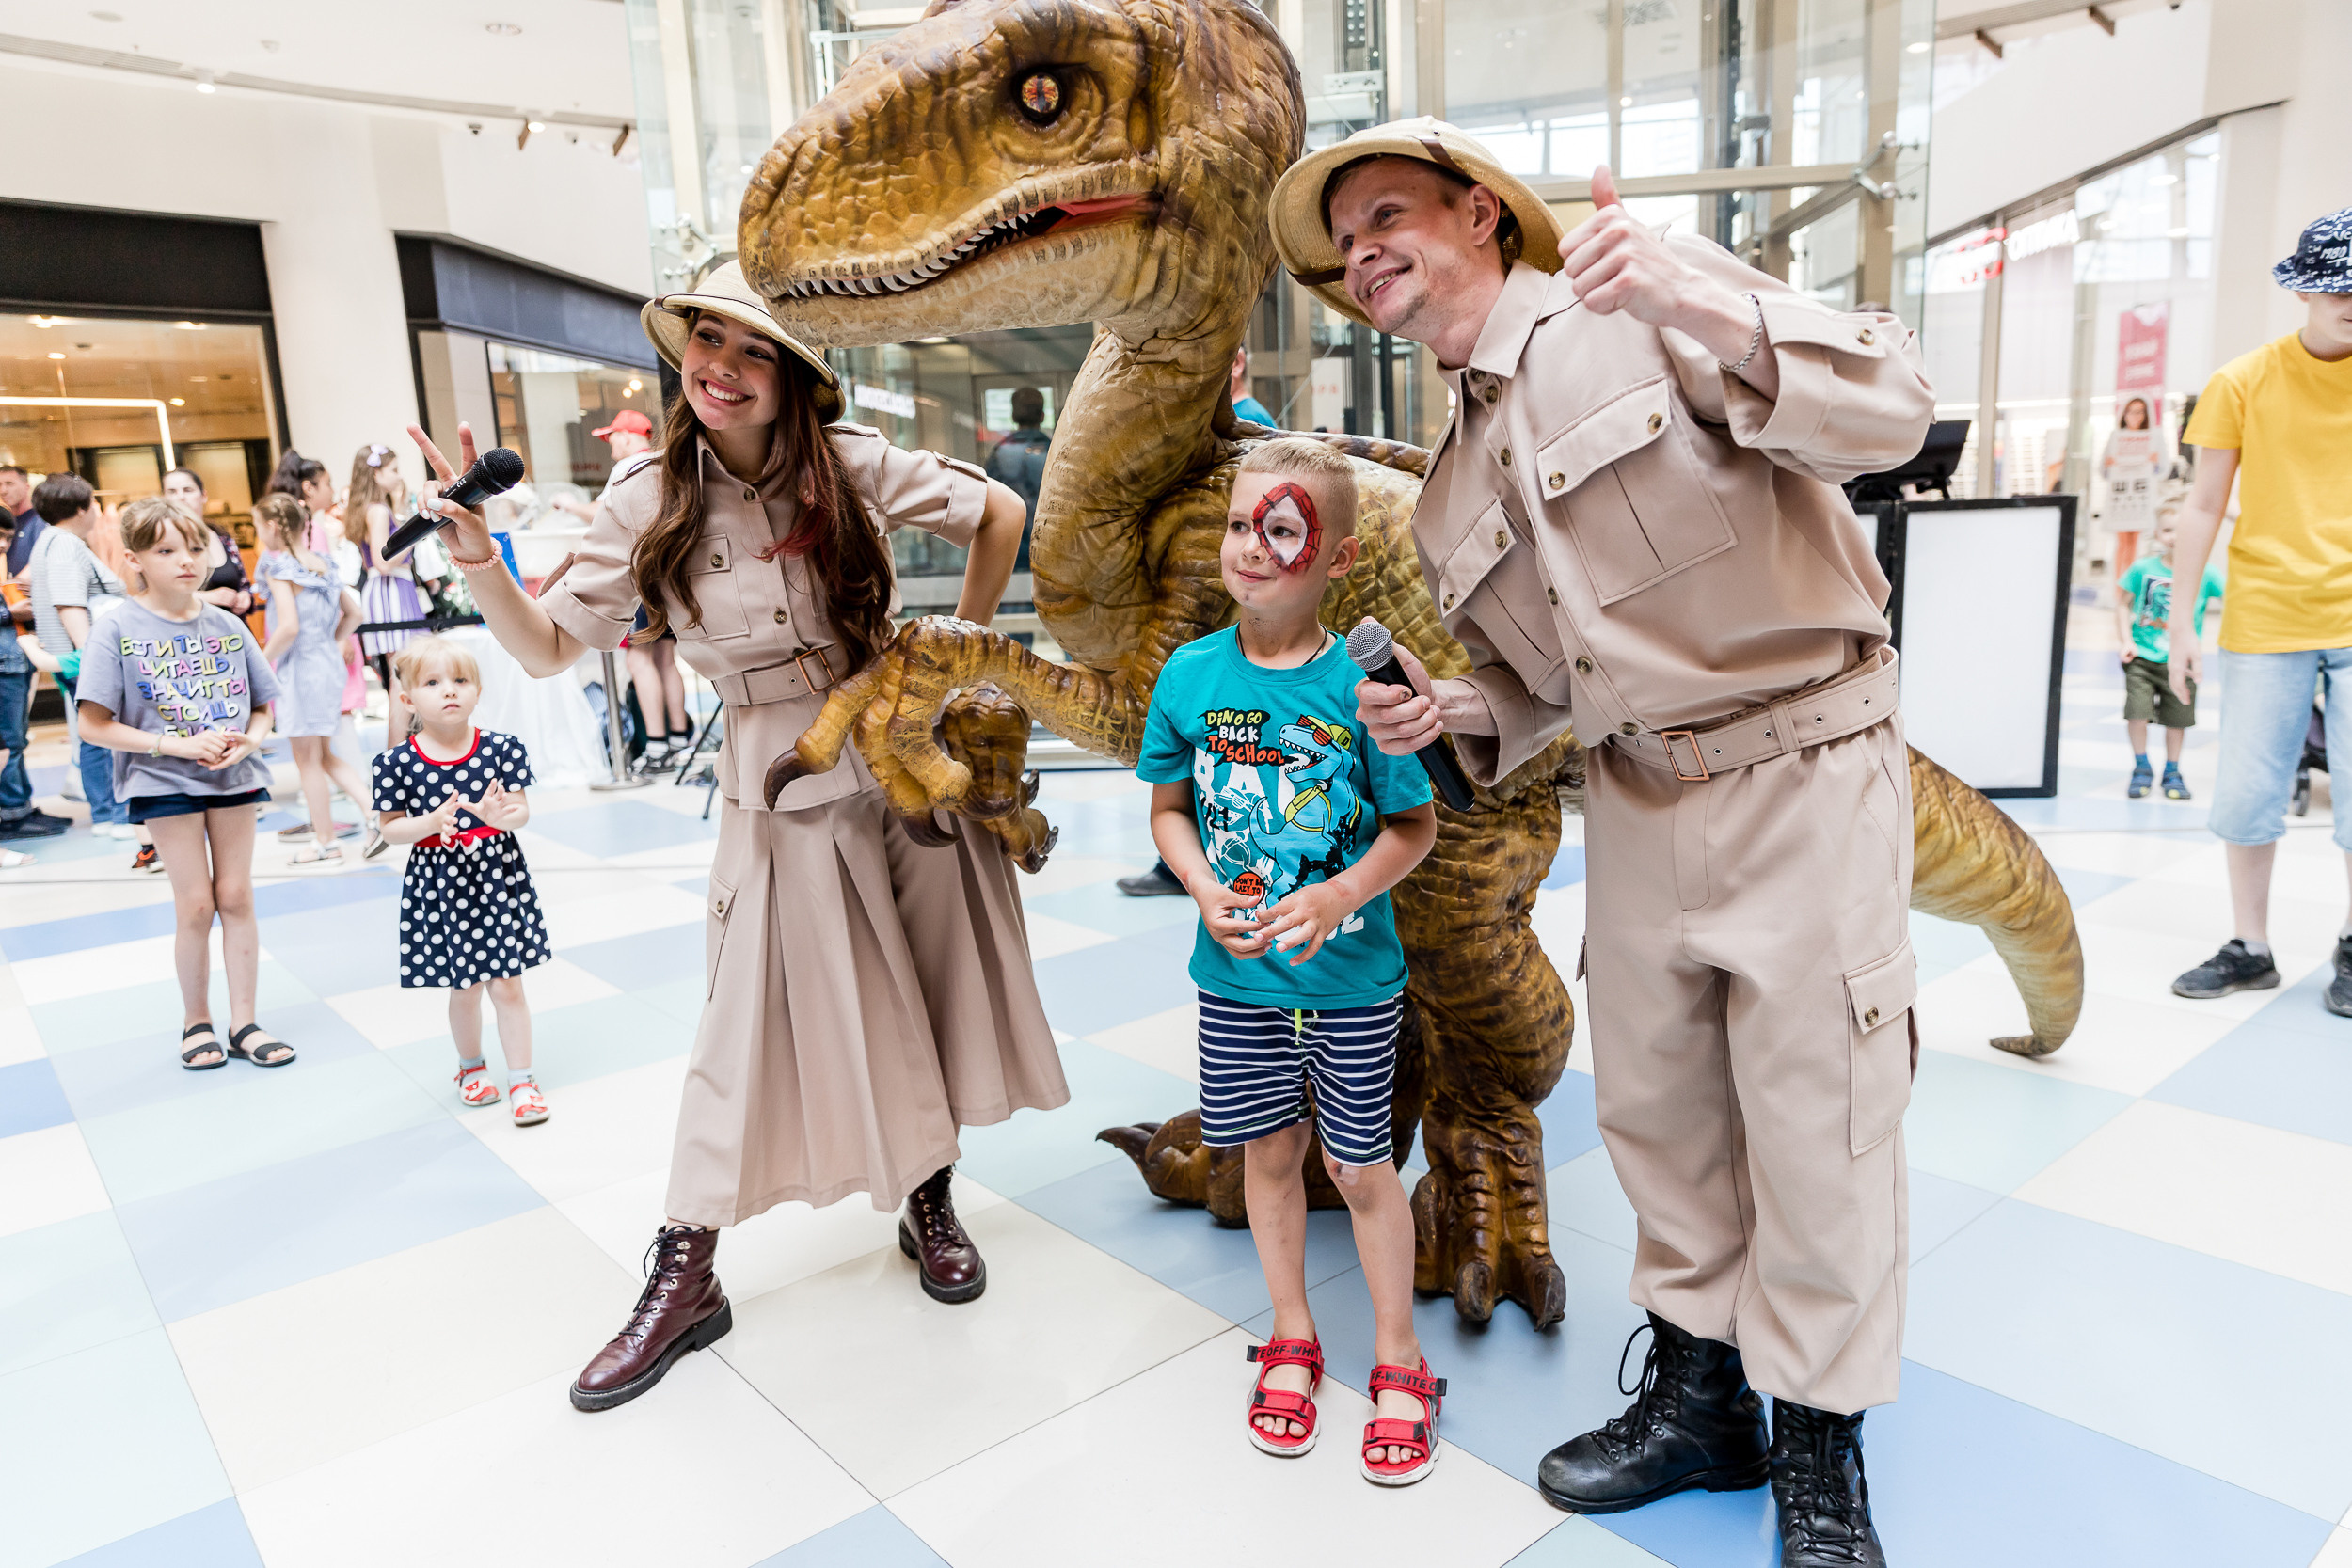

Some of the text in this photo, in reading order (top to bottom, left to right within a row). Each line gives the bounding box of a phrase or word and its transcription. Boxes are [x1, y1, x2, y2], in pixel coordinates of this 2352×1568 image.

[120, 633, 244, 657] ЕСЛИ ТЫ ЭТО
[138, 657, 236, 679] ЧИТАЕШЬ,
[136, 677, 247, 701] ЗНАЧИТ ТЫ
[157, 700, 240, 722] СТОИШЬ
[1246, 711, 1263, 724] GO
[1218, 725, 1259, 742] BACK
[1208, 736, 1229, 751] TO
[1225, 743, 1285, 764] SCHOOL
[1235, 877, 1254, 886] DON'T
[1235, 885, 1250, 894] LAZY
[1370, 1371, 1427, 1390] FF-WHITE
